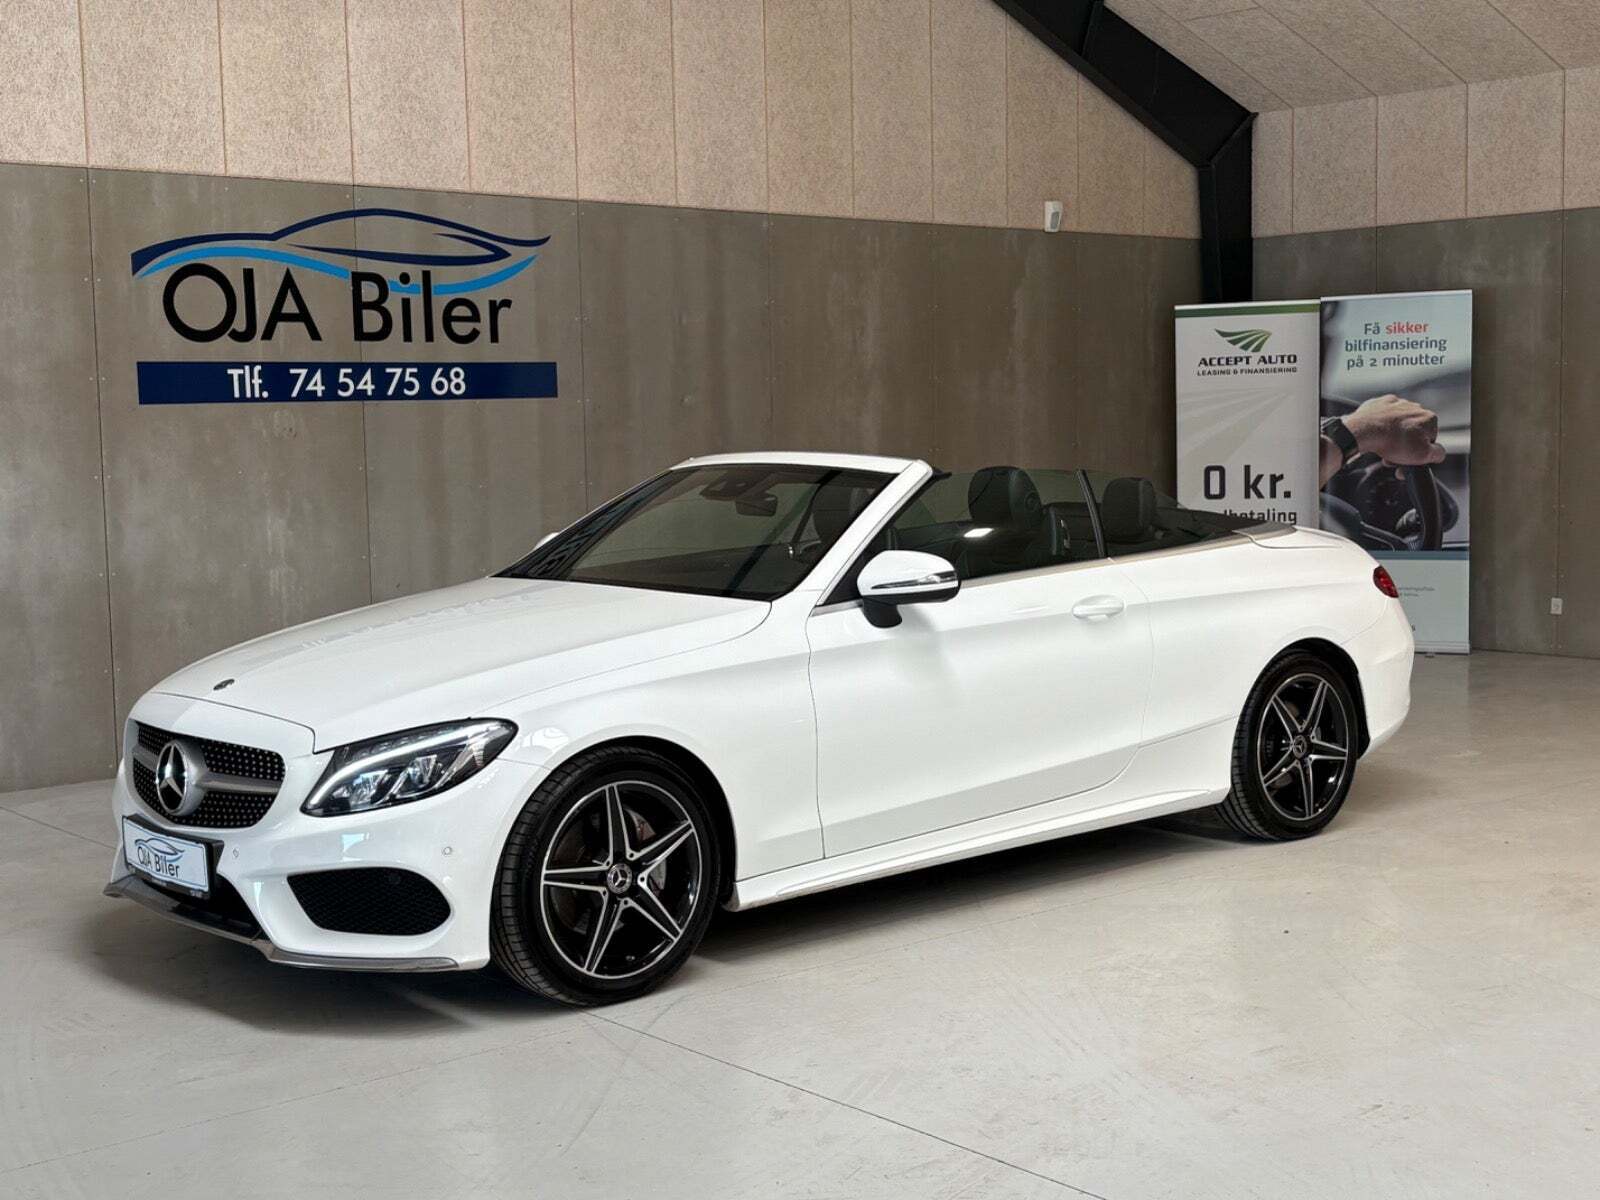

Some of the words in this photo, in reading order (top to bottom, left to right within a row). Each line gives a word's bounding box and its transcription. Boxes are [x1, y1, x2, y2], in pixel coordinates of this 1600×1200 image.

[163, 262, 322, 343] OJA
[350, 271, 512, 344] Biler
[1364, 322, 1380, 335] Få
[1385, 322, 1429, 335] sikker
[1345, 337, 1447, 352] bilfinansiering
[1198, 355, 1252, 367] ACCEPT
[1257, 354, 1297, 365] AUTO
[1347, 355, 1364, 370] på
[1369, 358, 1377, 367] 2
[1383, 354, 1445, 367] minutter
[1197, 368, 1231, 376] LEASING
[1240, 366, 1297, 374] FINANSIERING
[227, 365, 269, 398] Tlf.
[289, 368, 326, 397] 74
[337, 368, 376, 397] 54
[385, 367, 420, 396] 75
[430, 366, 466, 396] 68
[1204, 465, 1226, 500] 0
[1244, 464, 1291, 499] kr.
[154, 854, 179, 877] Biler
